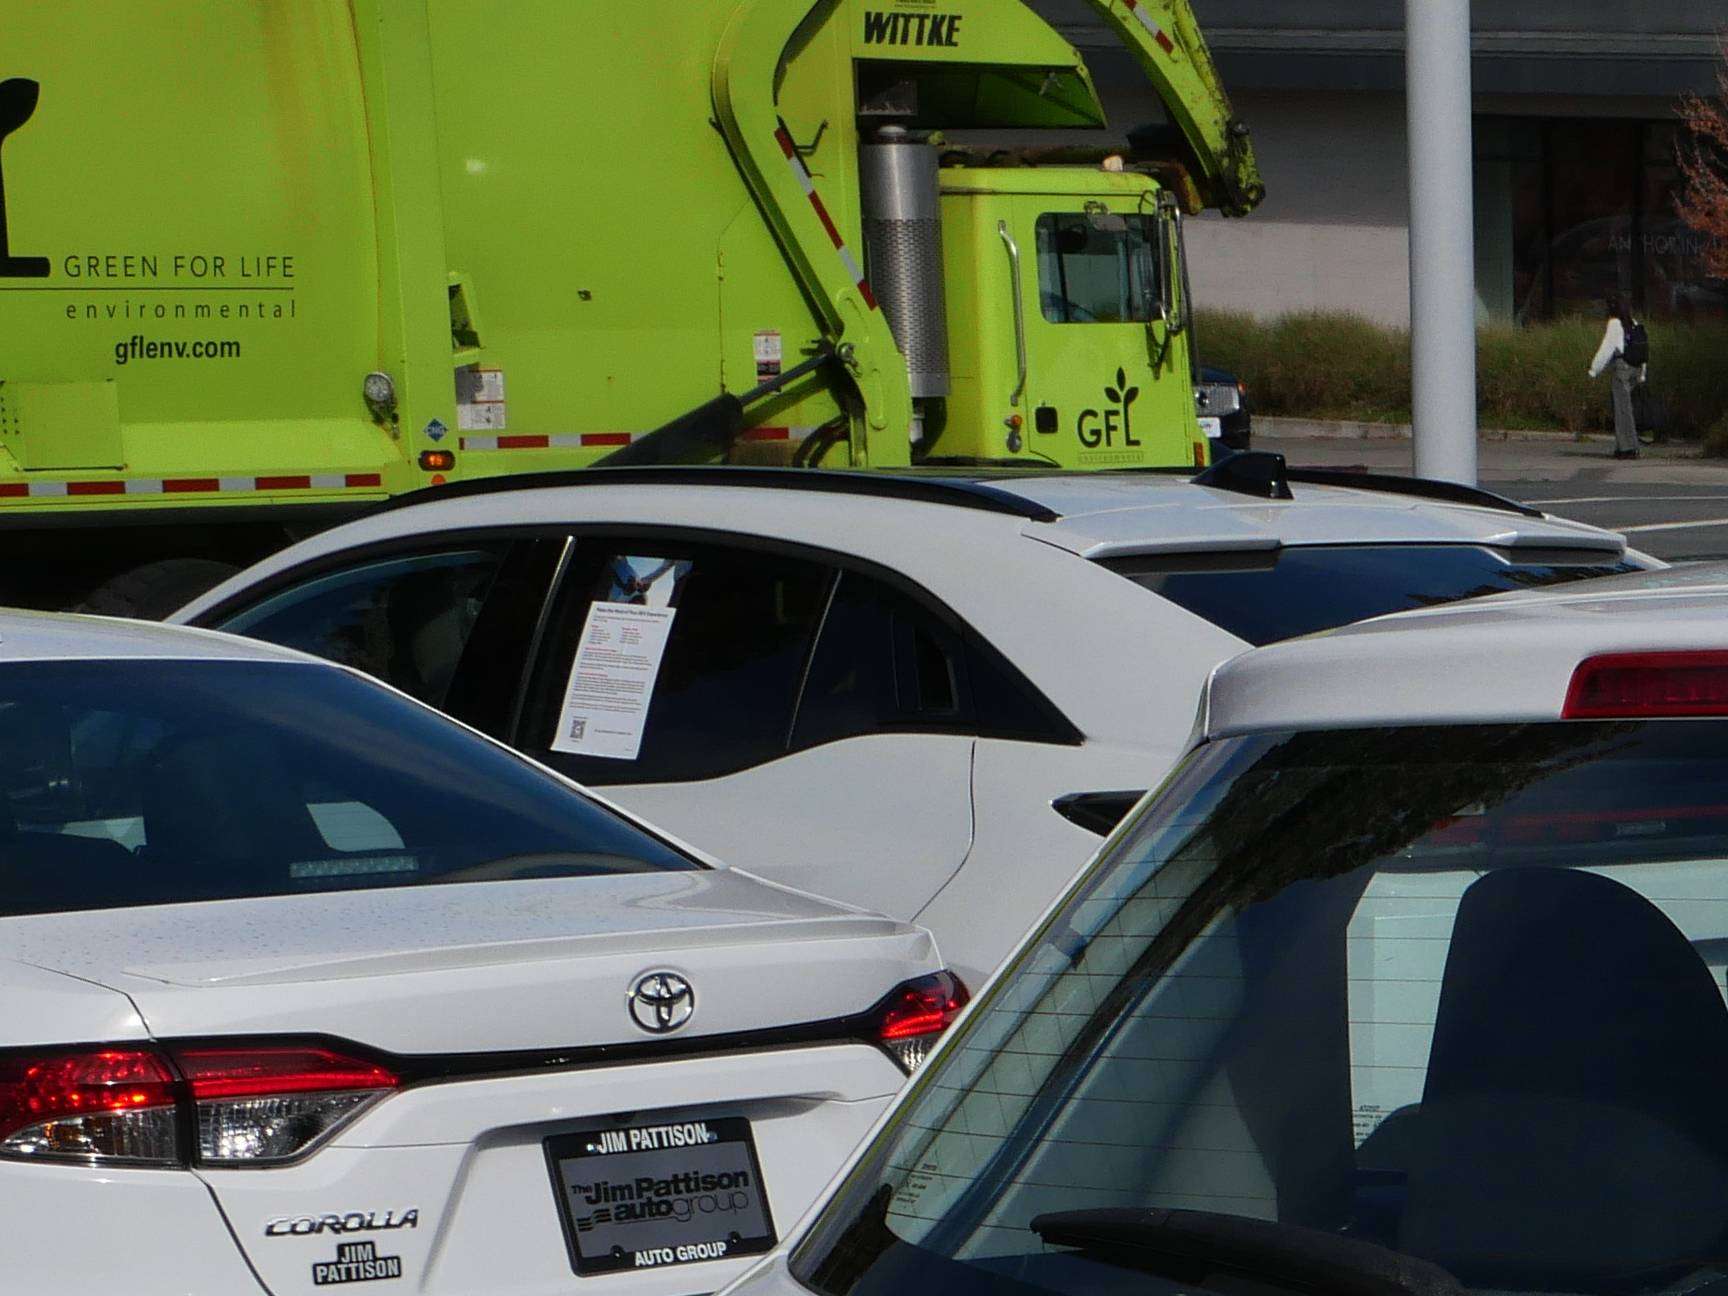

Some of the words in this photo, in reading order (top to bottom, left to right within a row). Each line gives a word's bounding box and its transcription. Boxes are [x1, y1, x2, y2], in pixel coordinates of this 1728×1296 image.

[864, 11, 962, 47] WITTKE
[64, 256, 158, 277] GREEN
[174, 256, 225, 277] FOR
[241, 256, 294, 277] LIFE
[66, 300, 295, 319] environmental
[115, 335, 241, 365] gflenv.com
[1077, 398, 1141, 448] GFL
[599, 1131, 628, 1154] JIM
[630, 1123, 709, 1150] PATTISON
[265, 1208, 419, 1236] COROLLA
[341, 1244, 373, 1262] JIM
[635, 1248, 675, 1266] AUTO
[677, 1242, 727, 1260] GROUP
[316, 1259, 399, 1282] PATTISON
